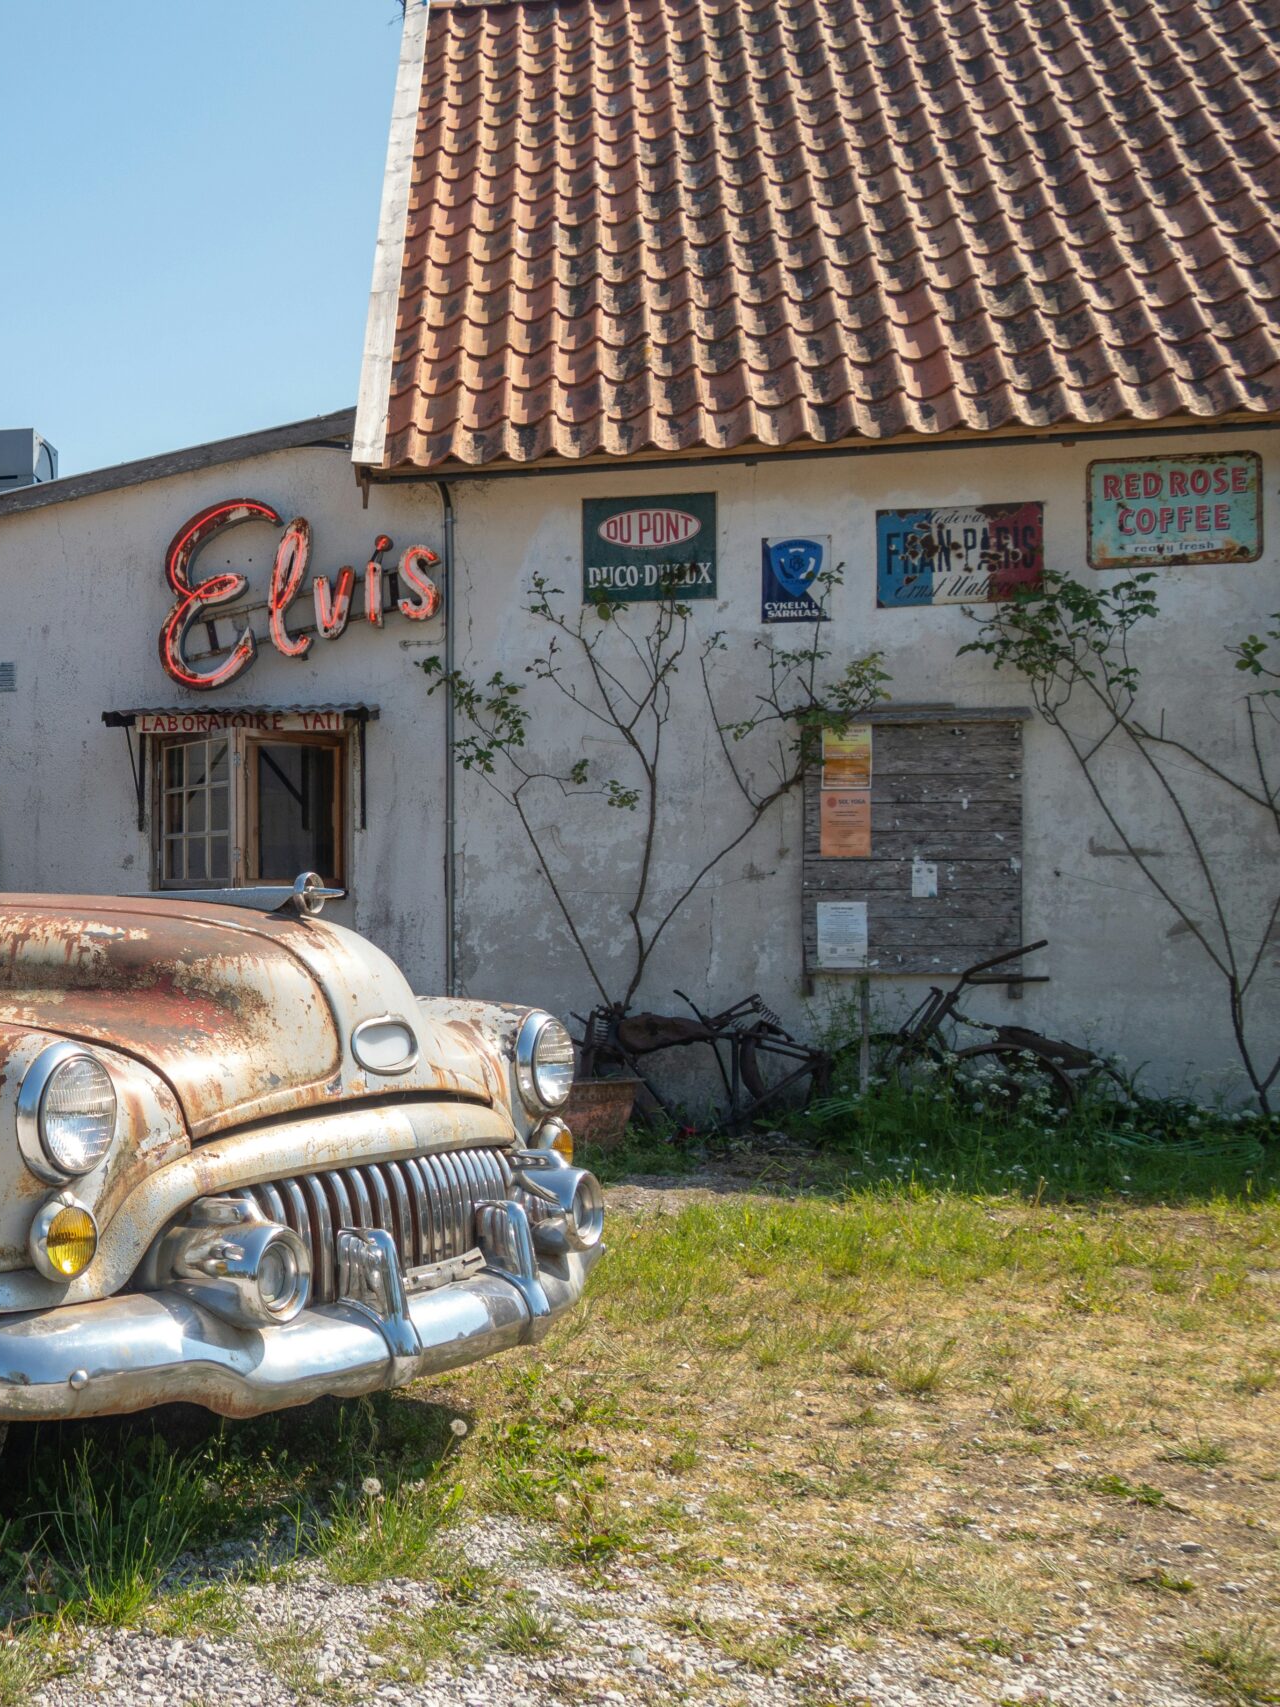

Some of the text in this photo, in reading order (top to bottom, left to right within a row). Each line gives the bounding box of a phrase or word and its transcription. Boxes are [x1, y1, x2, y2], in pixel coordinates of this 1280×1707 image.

[1103, 466, 1248, 500] RED ROSE
[606, 511, 693, 544] DU PONT
[1118, 503, 1231, 537] COFFEE
[1134, 541, 1214, 554] reay fresh
[159, 498, 442, 690] Elvis
[764, 601, 809, 610] CYKELN
[141, 712, 340, 732] LABORATOIRE TATI
